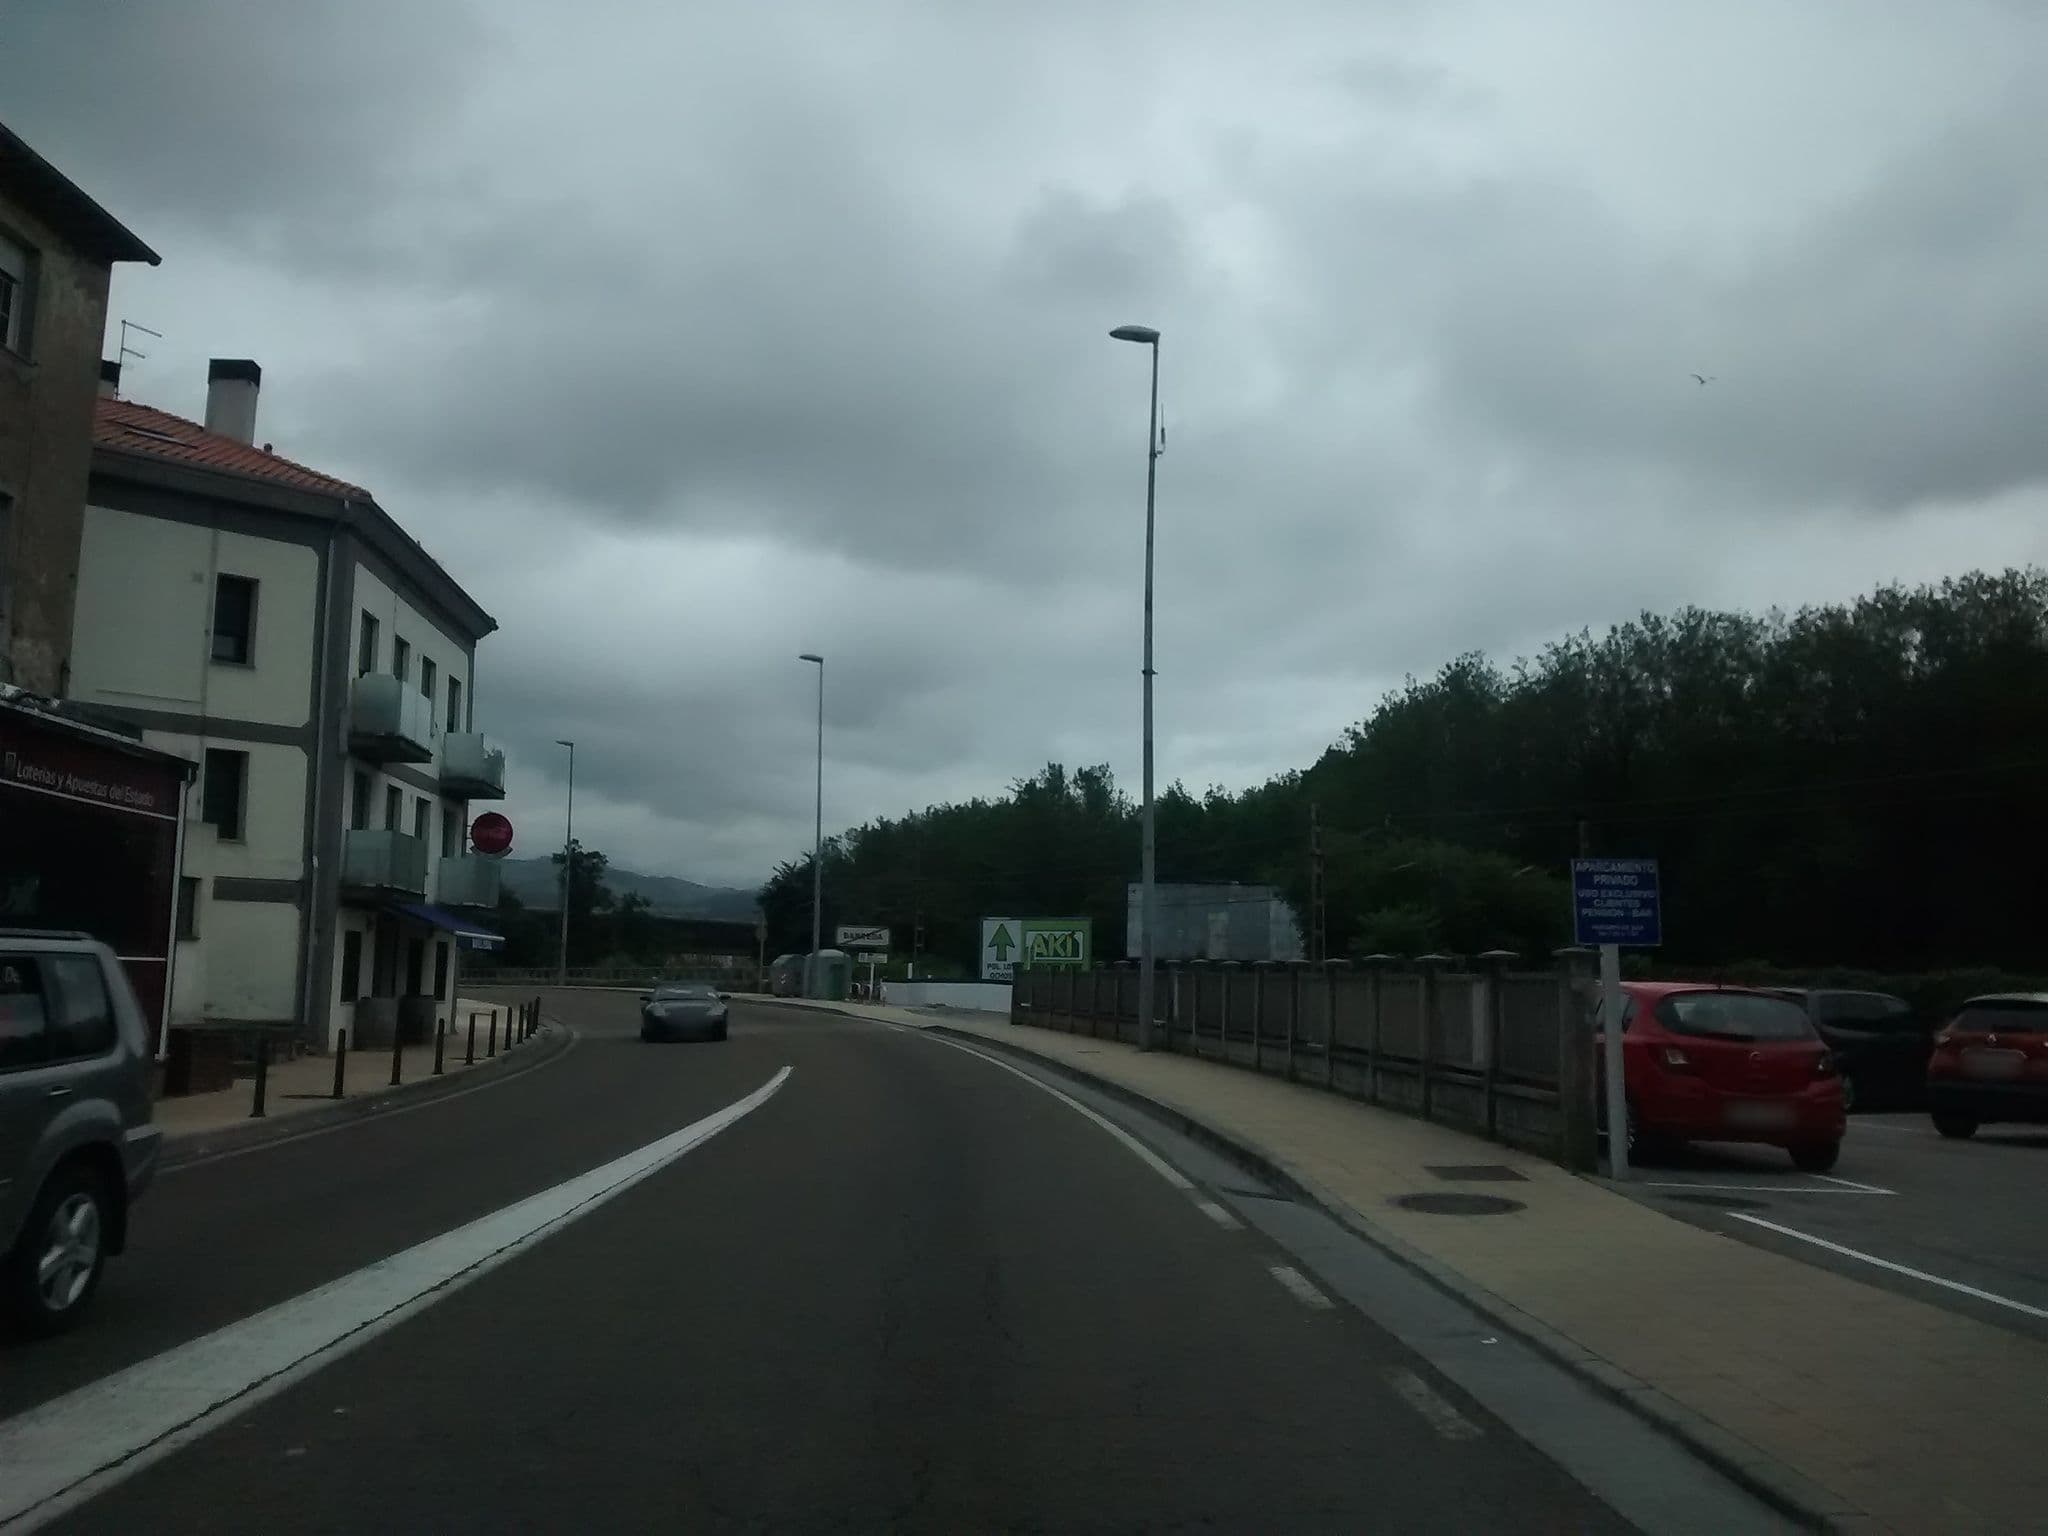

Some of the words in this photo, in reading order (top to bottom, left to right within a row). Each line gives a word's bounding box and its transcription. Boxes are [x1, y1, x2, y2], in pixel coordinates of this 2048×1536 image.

[56, 774, 64, 791] y
[109, 783, 124, 800] del
[1593, 875, 1639, 886] PRIVADO
